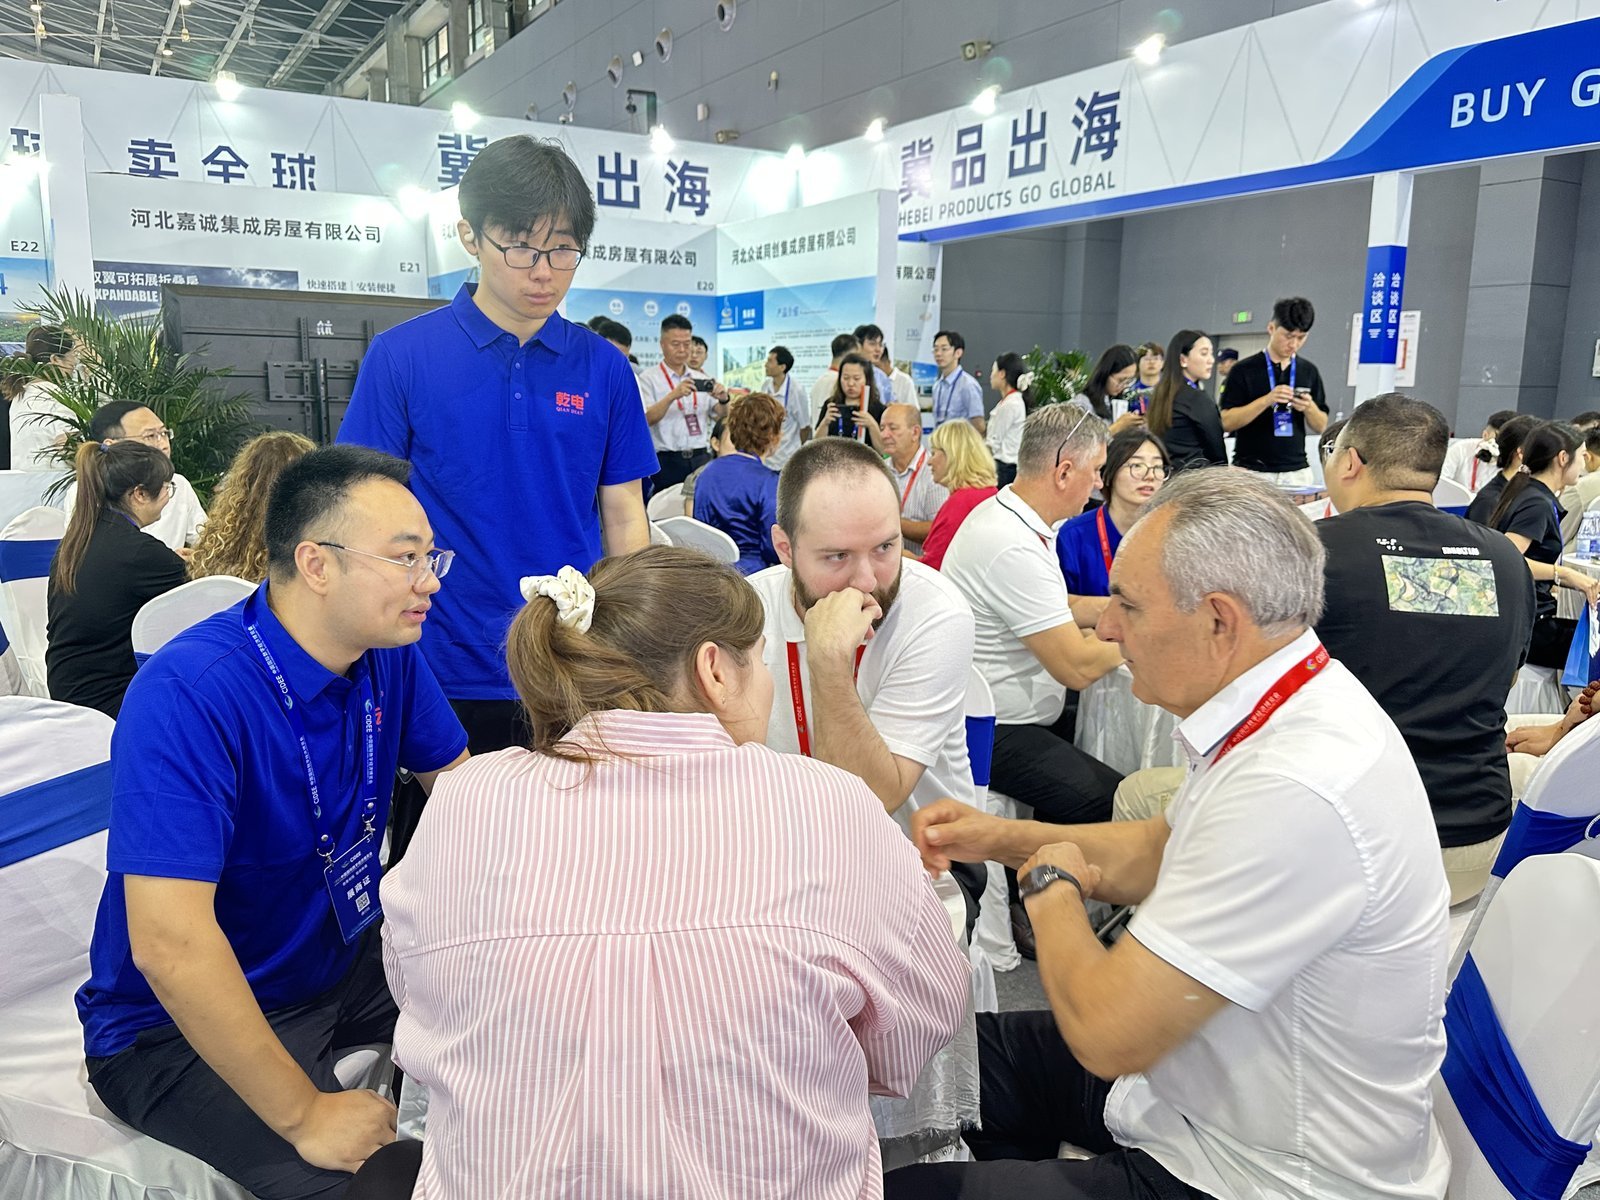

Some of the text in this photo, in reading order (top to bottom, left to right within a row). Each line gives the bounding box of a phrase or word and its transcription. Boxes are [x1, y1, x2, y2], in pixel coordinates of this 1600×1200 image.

[1450, 68, 1600, 129] BUY G
[127, 138, 317, 192] 卖全球
[900, 91, 1121, 205] 冀品出海
[898, 171, 1116, 227] HEBEI PRODUCTS GO GLOBAL
[10, 240, 40, 253] E22
[130, 208, 382, 244] 河北嘉诚集成房屋有限公司
[399, 262, 421, 273] E21
[586, 244, 697, 267] 成房屋有限公司
[95, 287, 160, 303] XPANDABLE
[696, 280, 715, 292] E20
[1369, 271, 1386, 324] 洽谈区
[1388, 271, 1402, 324] 洽谈区
